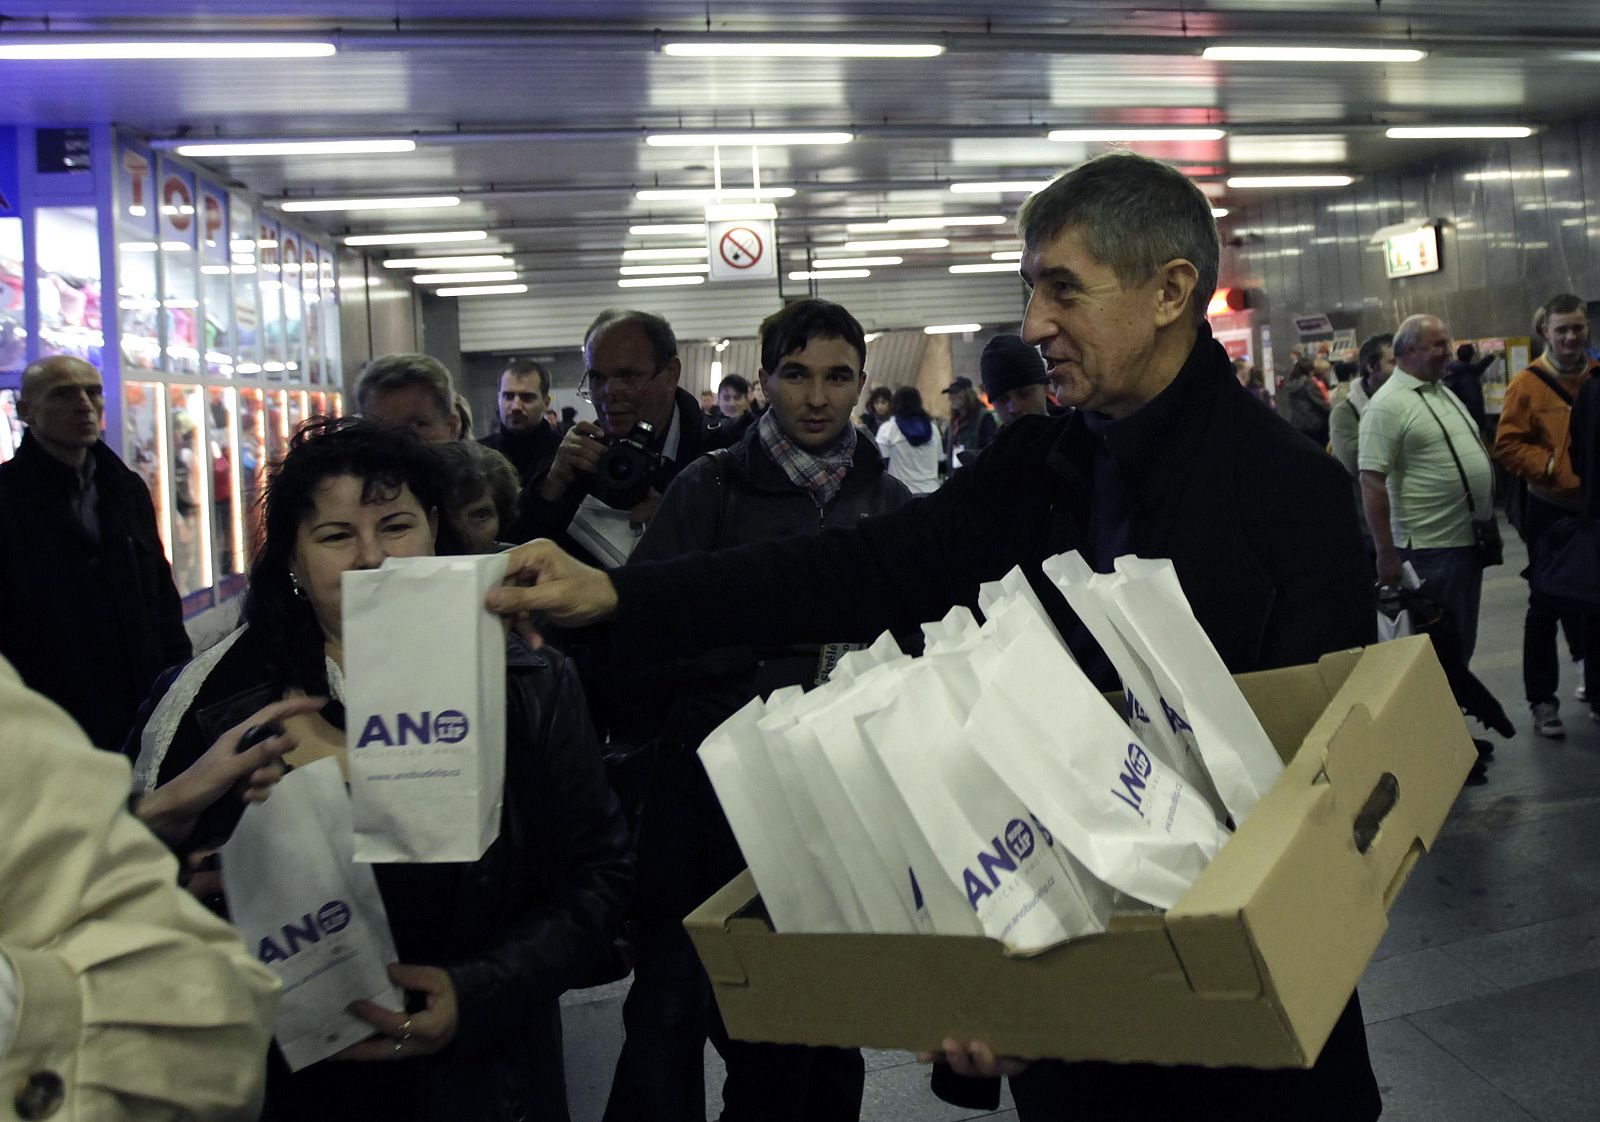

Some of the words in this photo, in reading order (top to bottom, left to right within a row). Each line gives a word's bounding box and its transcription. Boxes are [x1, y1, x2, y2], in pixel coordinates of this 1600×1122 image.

[123, 149, 222, 247] TOP
[355, 709, 469, 749] ANO
[963, 818, 1034, 912] ANO
[259, 900, 351, 965] ANO
